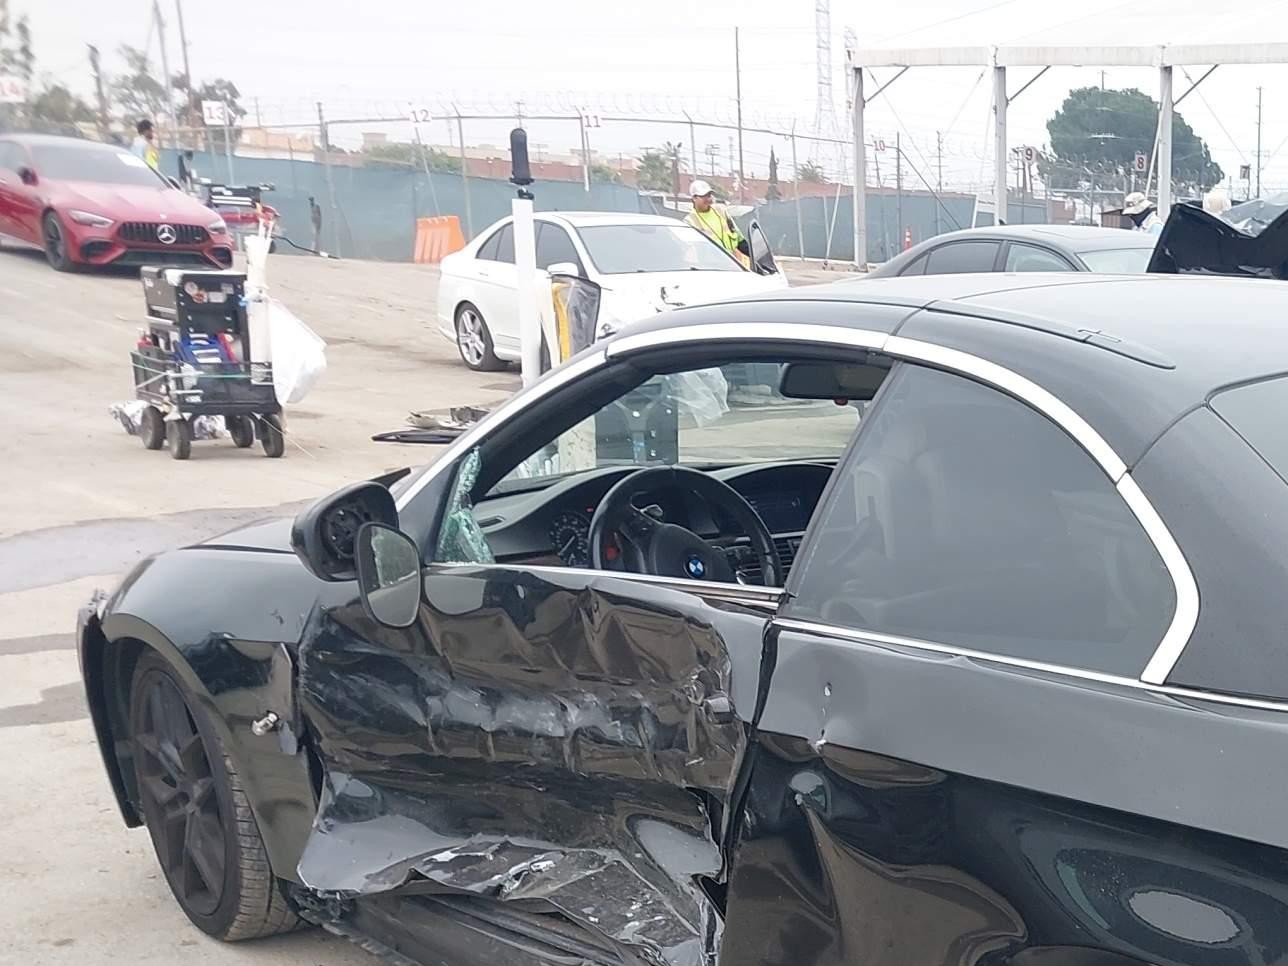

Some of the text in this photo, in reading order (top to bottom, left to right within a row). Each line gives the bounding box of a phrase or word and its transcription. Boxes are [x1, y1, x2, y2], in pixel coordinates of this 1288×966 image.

[205, 106, 225, 120] 13
[411, 109, 431, 123] 12
[584, 115, 600, 127] 11
[873, 140, 885, 151] 10
[1025, 147, 1033, 160] 9
[1137, 156, 1145, 170] 8
